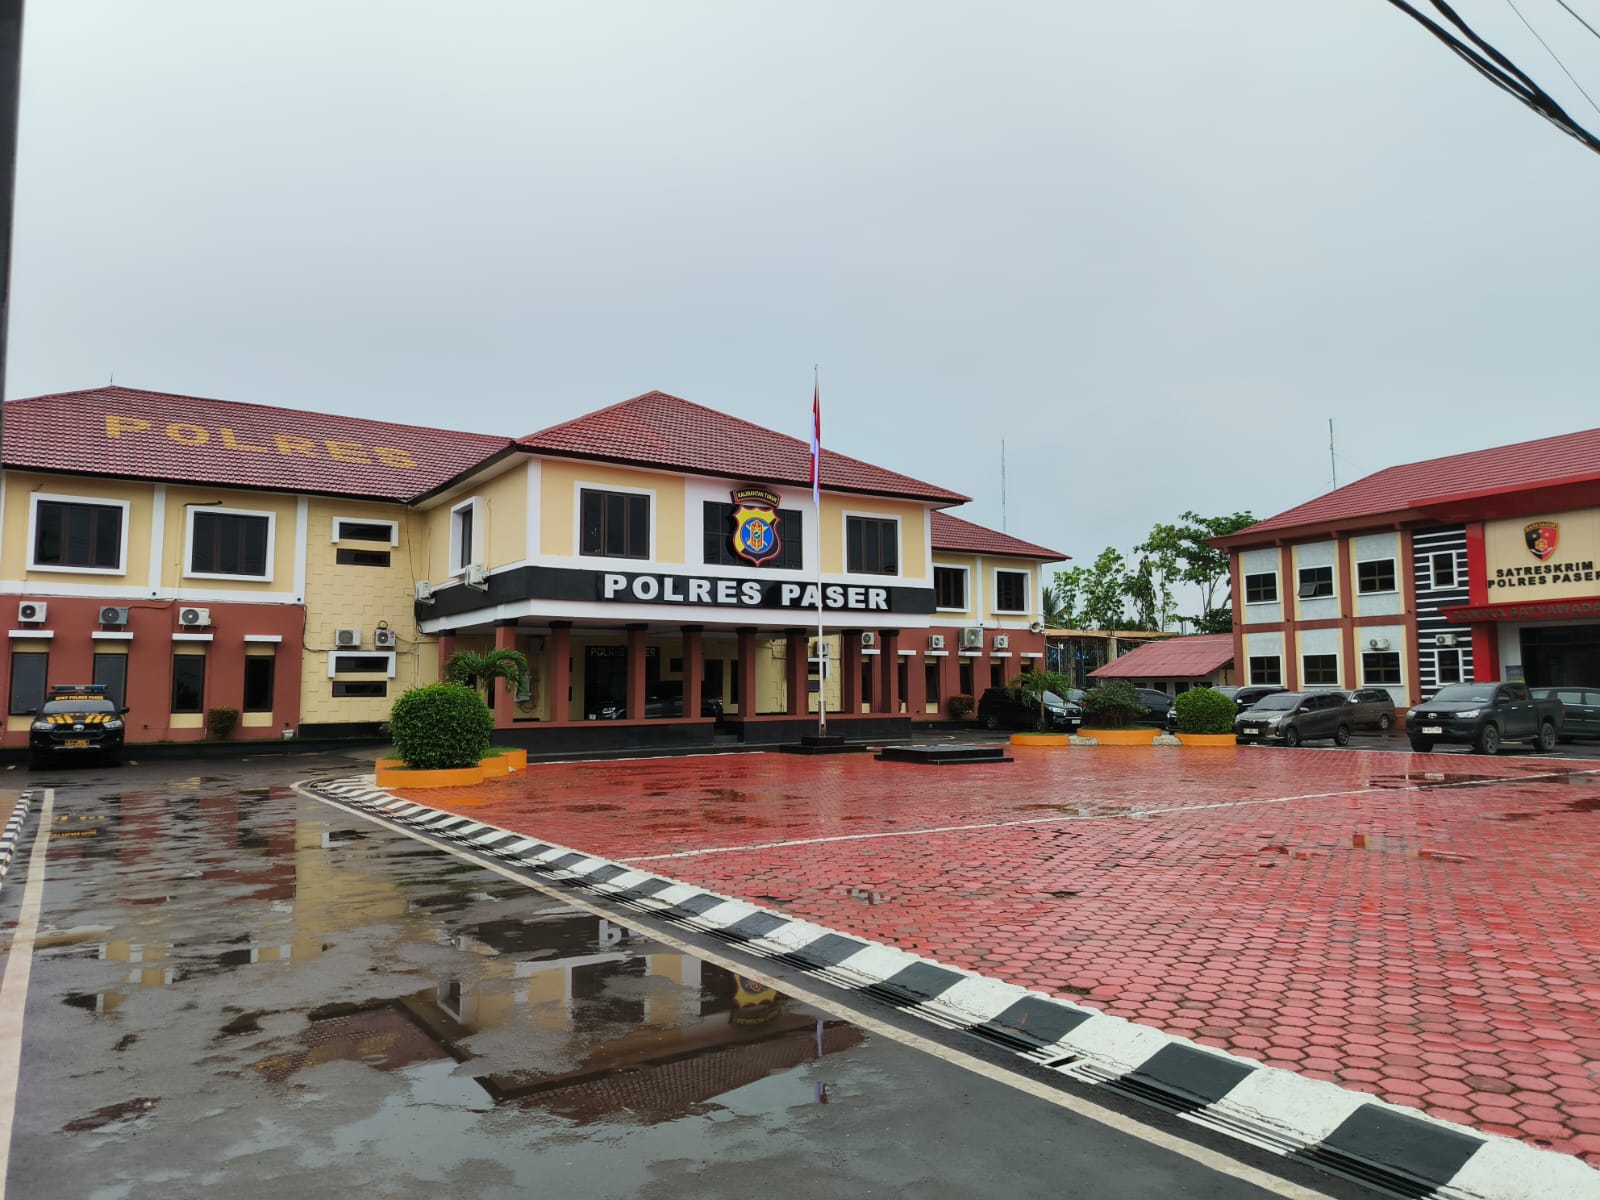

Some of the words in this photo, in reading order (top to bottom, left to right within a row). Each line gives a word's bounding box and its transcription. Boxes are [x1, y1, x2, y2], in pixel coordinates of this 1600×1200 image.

[105, 415, 417, 469] POLRES
[1488, 575, 1547, 588] POLRES
[1496, 561, 1593, 578] SATRESKRIM
[604, 574, 762, 605] POLRES
[781, 584, 888, 609] PASER
